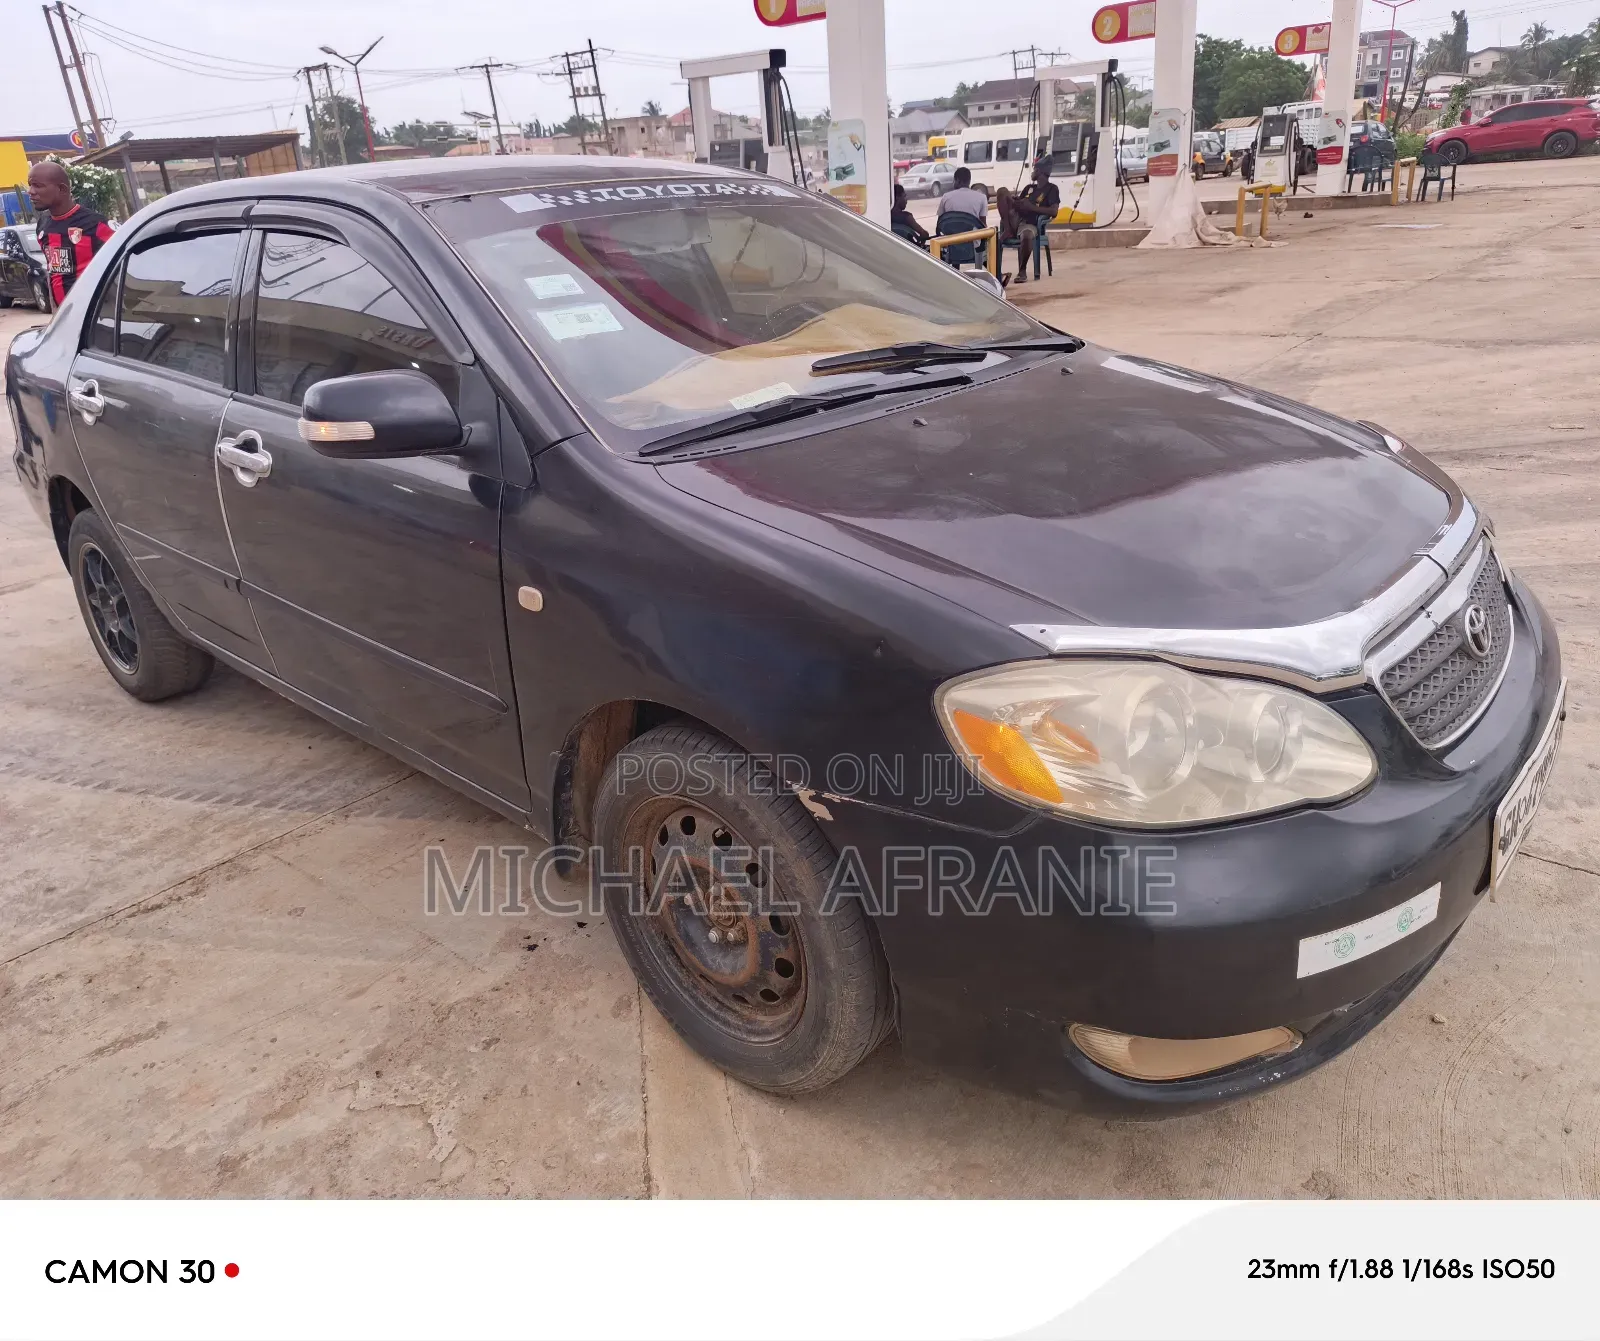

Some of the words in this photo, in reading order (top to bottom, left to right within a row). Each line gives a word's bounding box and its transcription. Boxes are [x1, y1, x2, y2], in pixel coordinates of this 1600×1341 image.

[1102, 15, 1114, 36] 2
[1283, 34, 1294, 50] 3
[590, 184, 737, 200] TOYOTA
